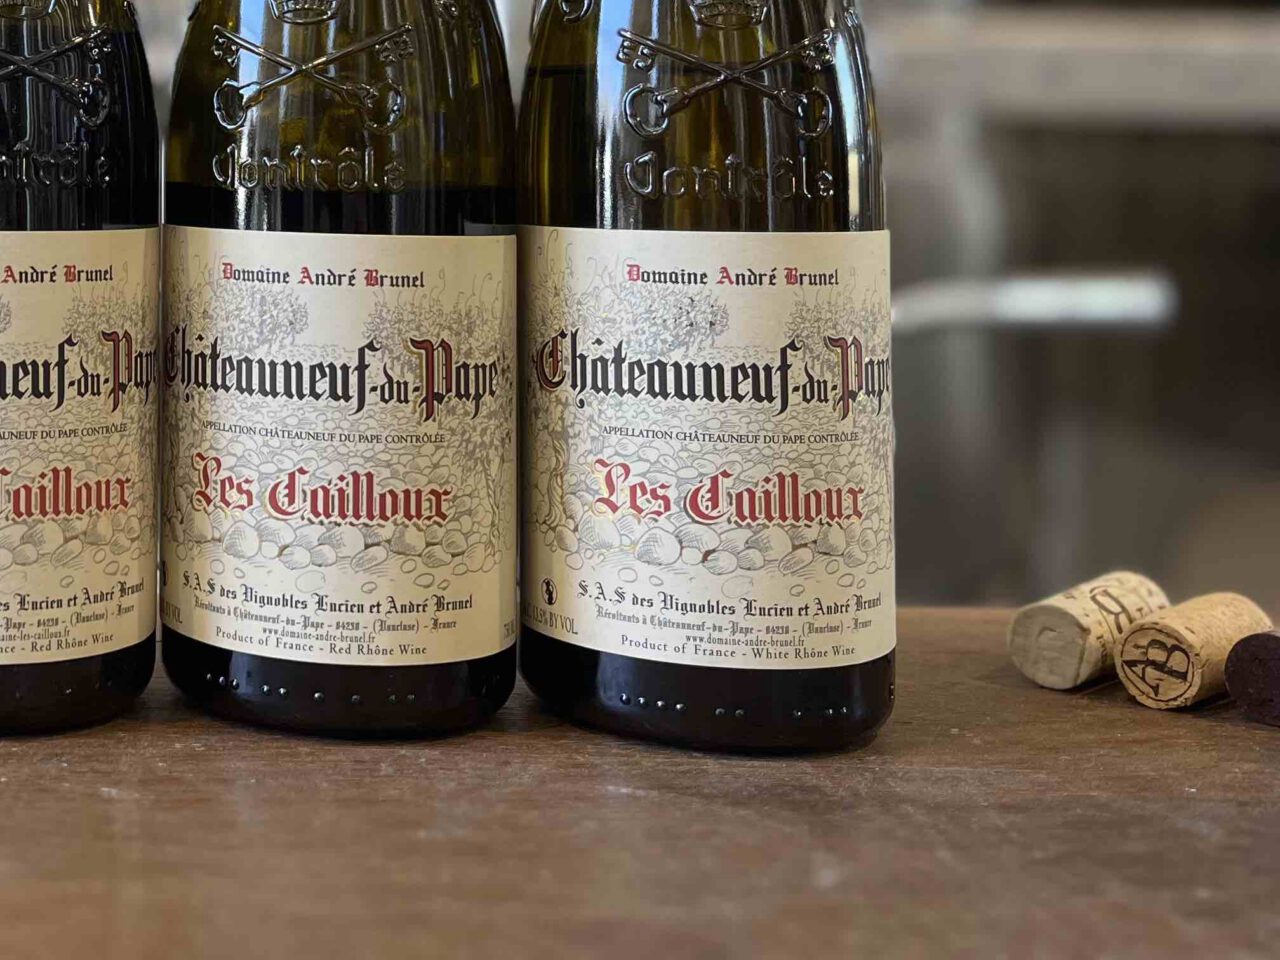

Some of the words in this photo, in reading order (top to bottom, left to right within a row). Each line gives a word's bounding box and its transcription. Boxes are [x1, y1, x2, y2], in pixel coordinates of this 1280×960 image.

[0, 265, 57, 283] André
[64, 264, 114, 283] Brunel
[222, 262, 290, 284] Domaine
[298, 266, 356, 287] André
[364, 268, 425, 288] Brunel
[626, 263, 708, 285] Domaine
[716, 265, 776, 286] André
[784, 266, 838, 286] Brunel
[164, 324, 498, 422] Châteauneuf-du-Pape
[40, 428, 56, 439] DU
[58, 428, 79, 438] PAPE
[81, 422, 128, 436] CONTRÔLÉE
[201, 420, 257, 435] APPELLATION
[259, 426, 336, 442] CHÂTEAUNEUF
[339, 432, 356, 443] DU
[359, 433, 383, 444] PAPE
[385, 429, 445, 444] CONTRÔLÉE
[602, 425, 673, 440] APPELLATION
[675, 429, 759, 444] CHÂTEAUNEUF
[763, 433, 781, 444] DU
[783, 433, 805, 444] PAPE
[807, 429, 859, 443] CONTRÔLÉE
[192, 451, 254, 512] Les
[268, 465, 454, 522] Cailloux
[594, 459, 672, 521] Les
[687, 468, 864, 525] Cailloux
[13, 593, 63, 616] Lucien
[67, 596, 78, 608] et
[80, 587, 115, 611] André
[117, 577, 145, 602] Brunel
[220, 585, 237, 600] des
[240, 583, 308, 609] Vignobles
[311, 592, 364, 616] Lucien
[369, 600, 382, 613] et
[385, 595, 428, 618] André
[432, 594, 472, 617] Brunel
[632, 594, 654, 608] des
[658, 591, 736, 615] Vignobles
[739, 597, 793, 621] Lucien
[798, 603, 810, 616] et
[813, 597, 850, 619] André
[853, 592, 881, 616] Brunel
[31, 641, 52, 652] Red
[56, 637, 88, 649] Rhône
[91, 633, 114, 645] Wine
[216, 626, 253, 644] Product
[258, 635, 270, 646] of
[276, 637, 314, 652] France
[329, 643, 351, 654] Red
[357, 643, 394, 656] Rhône
[399, 644, 427, 655] Wine
[621, 634, 667, 651] Product
[674, 642, 686, 654] of
[694, 645, 736, 657] France
[751, 646, 789, 659] White
[794, 646, 828, 659] Rhône
[831, 644, 856, 656] Wine
